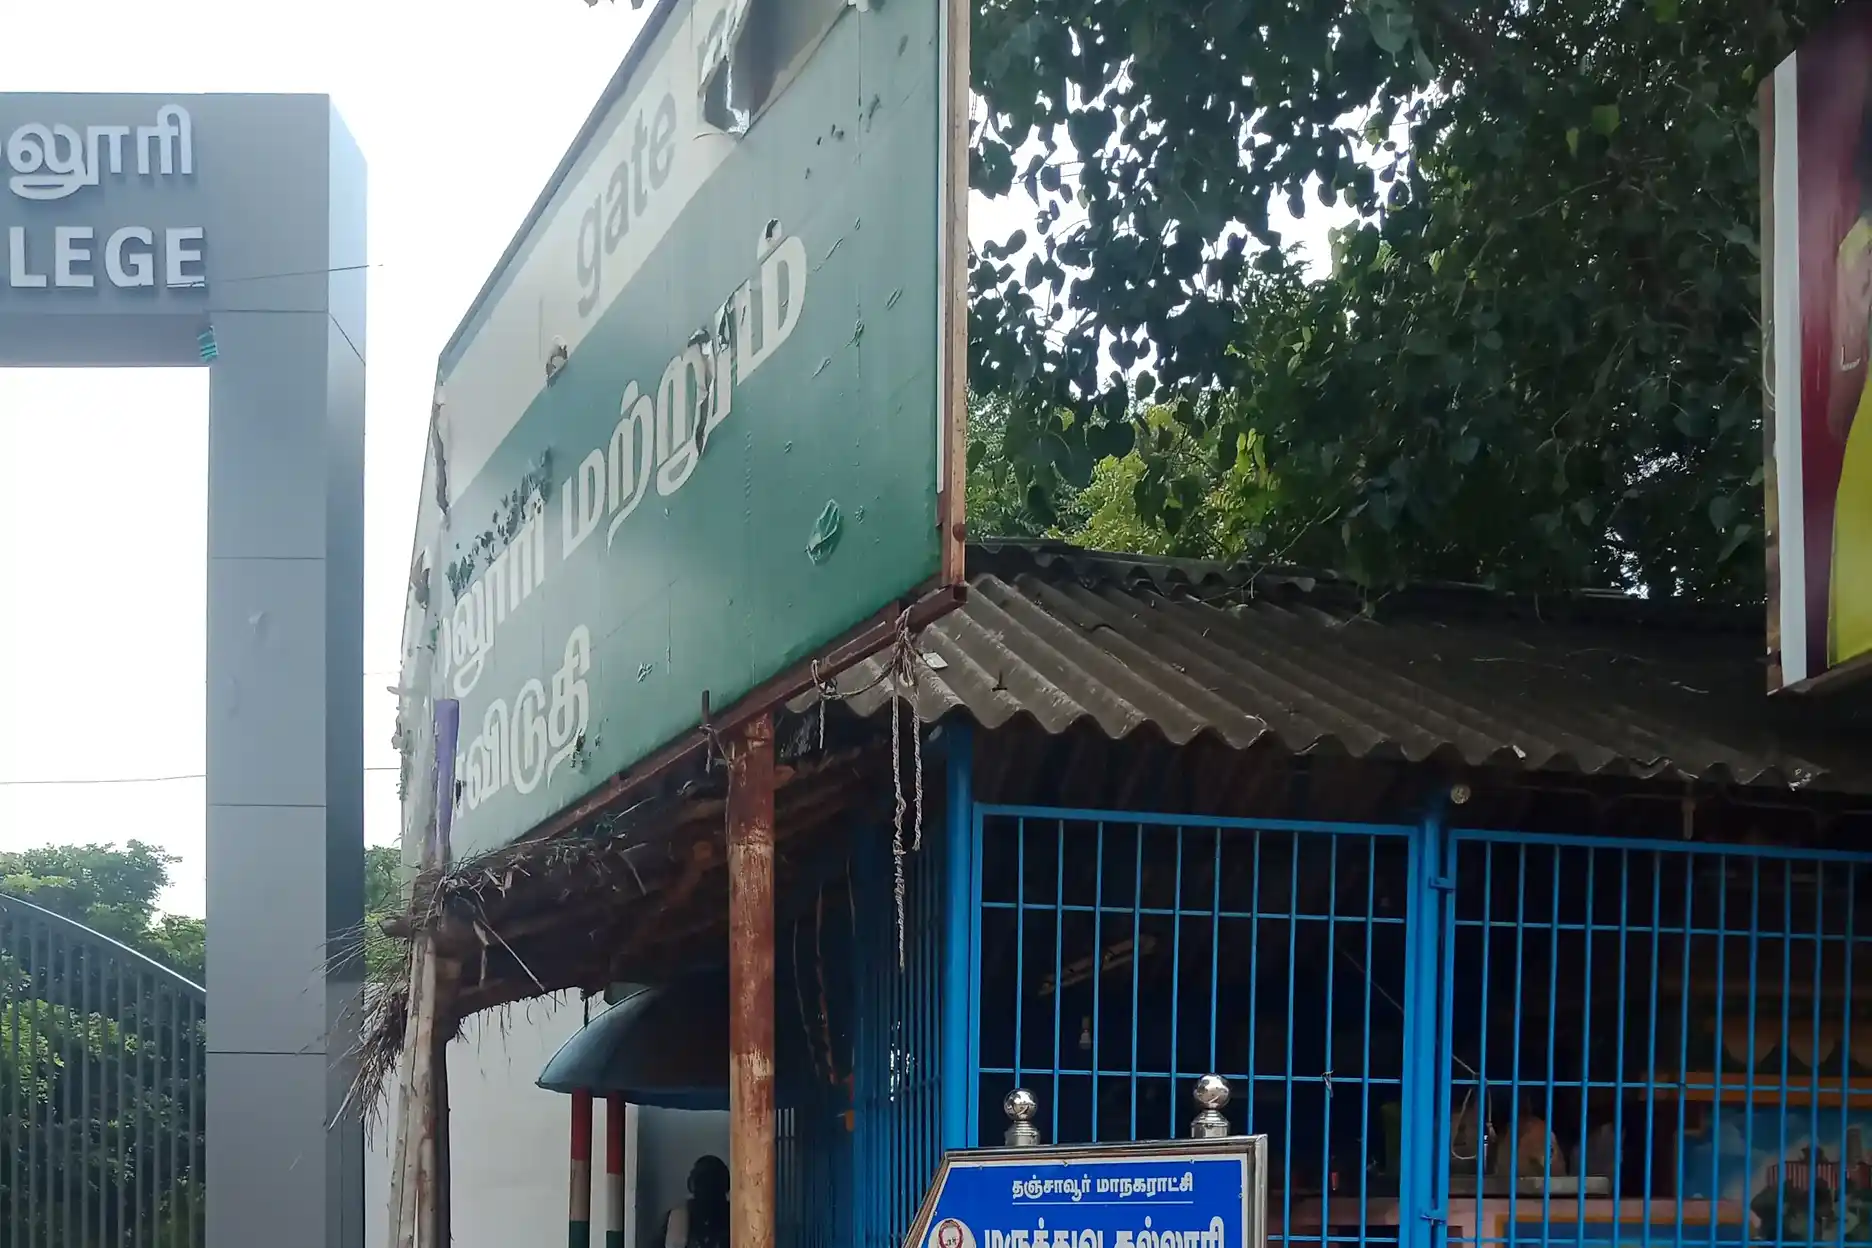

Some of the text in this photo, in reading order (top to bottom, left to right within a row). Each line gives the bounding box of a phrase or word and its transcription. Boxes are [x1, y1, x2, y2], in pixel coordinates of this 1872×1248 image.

[9, 226, 206, 288] LEGE
[577, 92, 677, 318] gate
[440, 486, 545, 699] லூரி
[455, 624, 591, 819] விடுதி
[1012, 1171, 1193, 1202] தஞ்சாவூர் மாநகராட்சி
